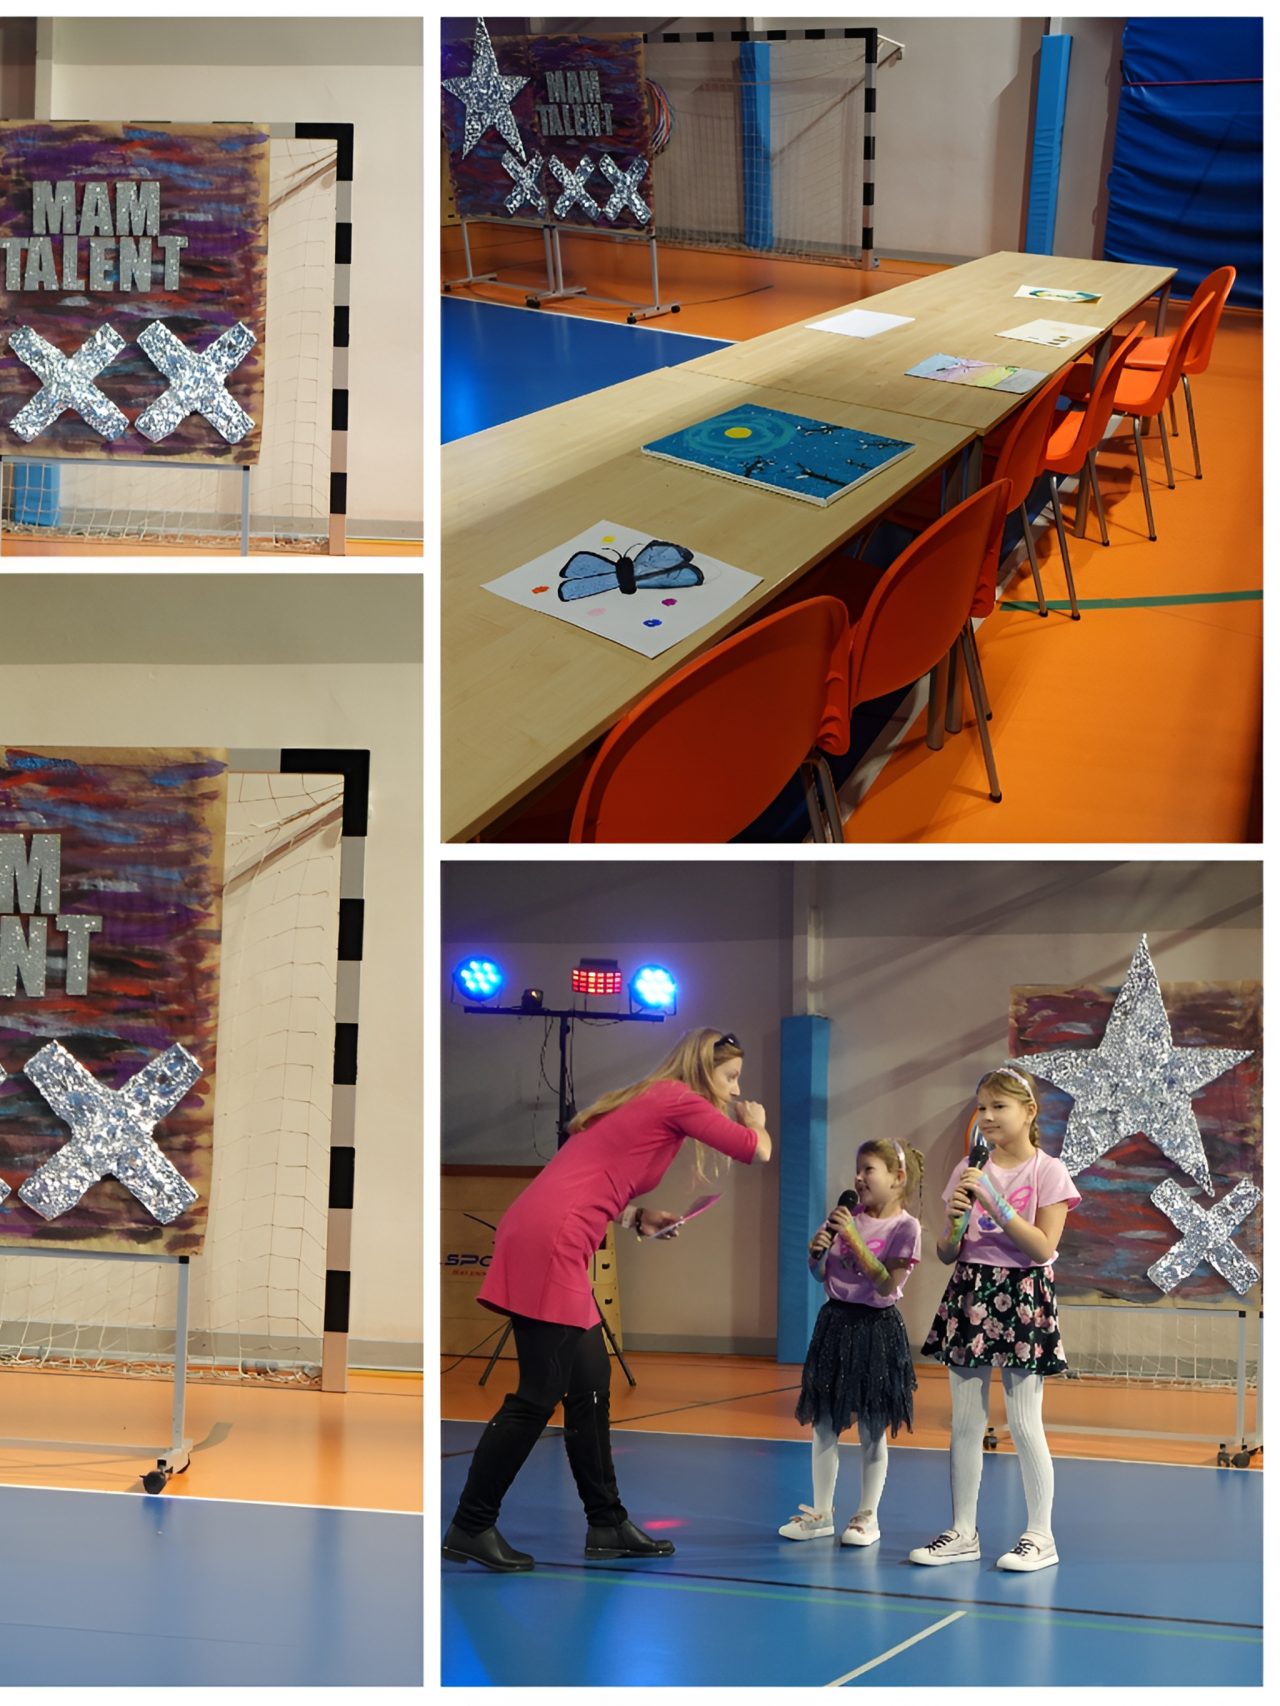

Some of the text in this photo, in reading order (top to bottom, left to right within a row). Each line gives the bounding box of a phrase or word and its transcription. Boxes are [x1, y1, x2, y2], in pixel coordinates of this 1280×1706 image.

[545, 71, 602, 103] MAM
[536, 103, 614, 136] TALENT
[33, 180, 160, 236] MAM
[0, 235, 188, 292] TALENT
